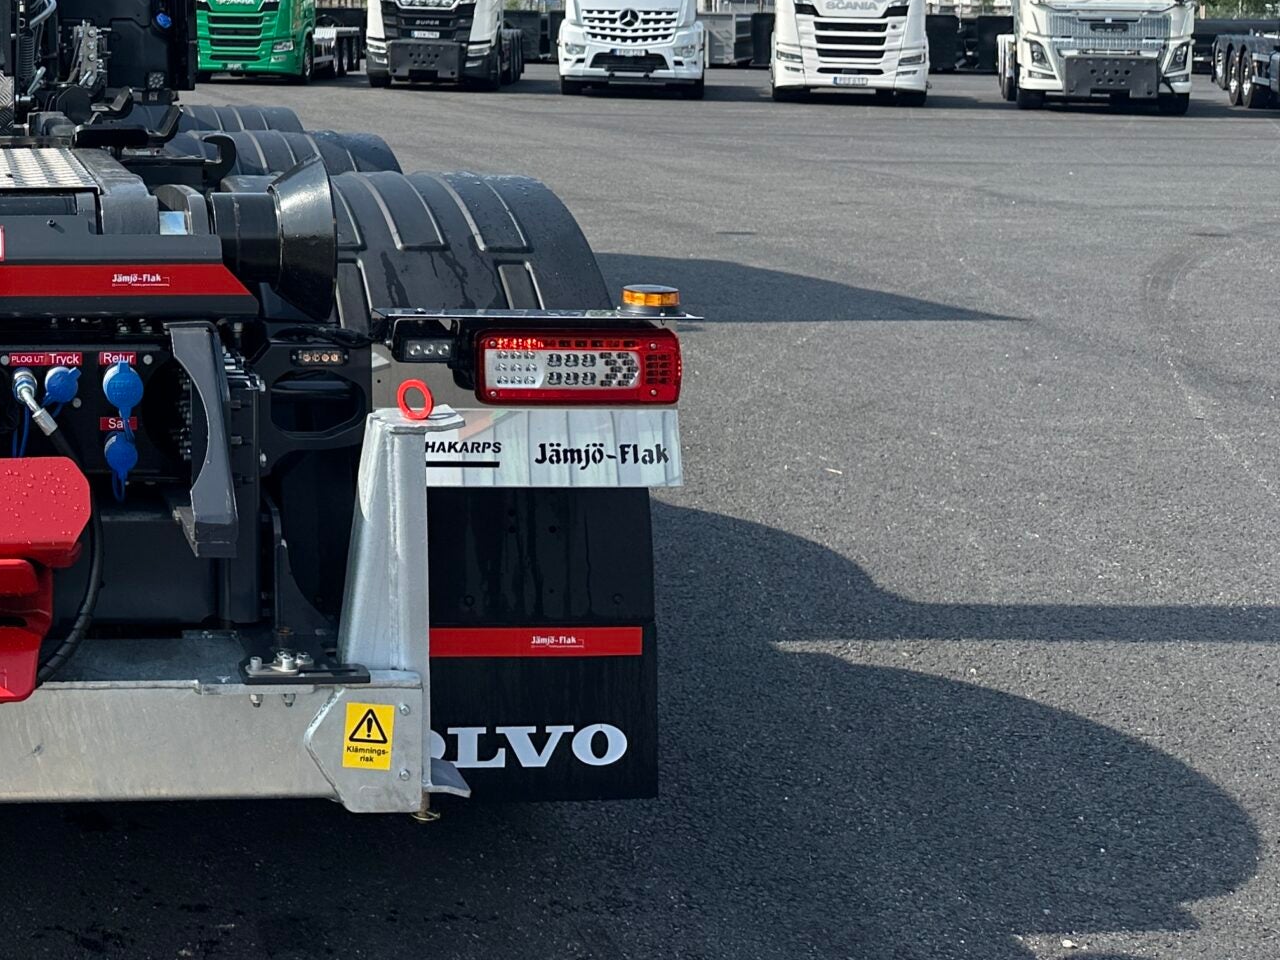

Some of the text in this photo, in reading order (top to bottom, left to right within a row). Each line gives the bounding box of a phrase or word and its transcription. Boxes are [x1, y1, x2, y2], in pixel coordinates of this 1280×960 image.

[826, 0, 878, 11] SCANIA
[112, 273, 161, 284] Jämjö-Flak
[11, 355, 32, 363] PLOG
[49, 353, 79, 365] Tryck
[103, 351, 134, 363] Retur
[425, 441, 502, 454] HAKARPS
[534, 443, 670, 470] Jämjö-Flak
[531, 635, 577, 646] Jämjö-Flak
[346, 745, 389, 756] Klämnings-
[430, 723, 628, 769] LVO
